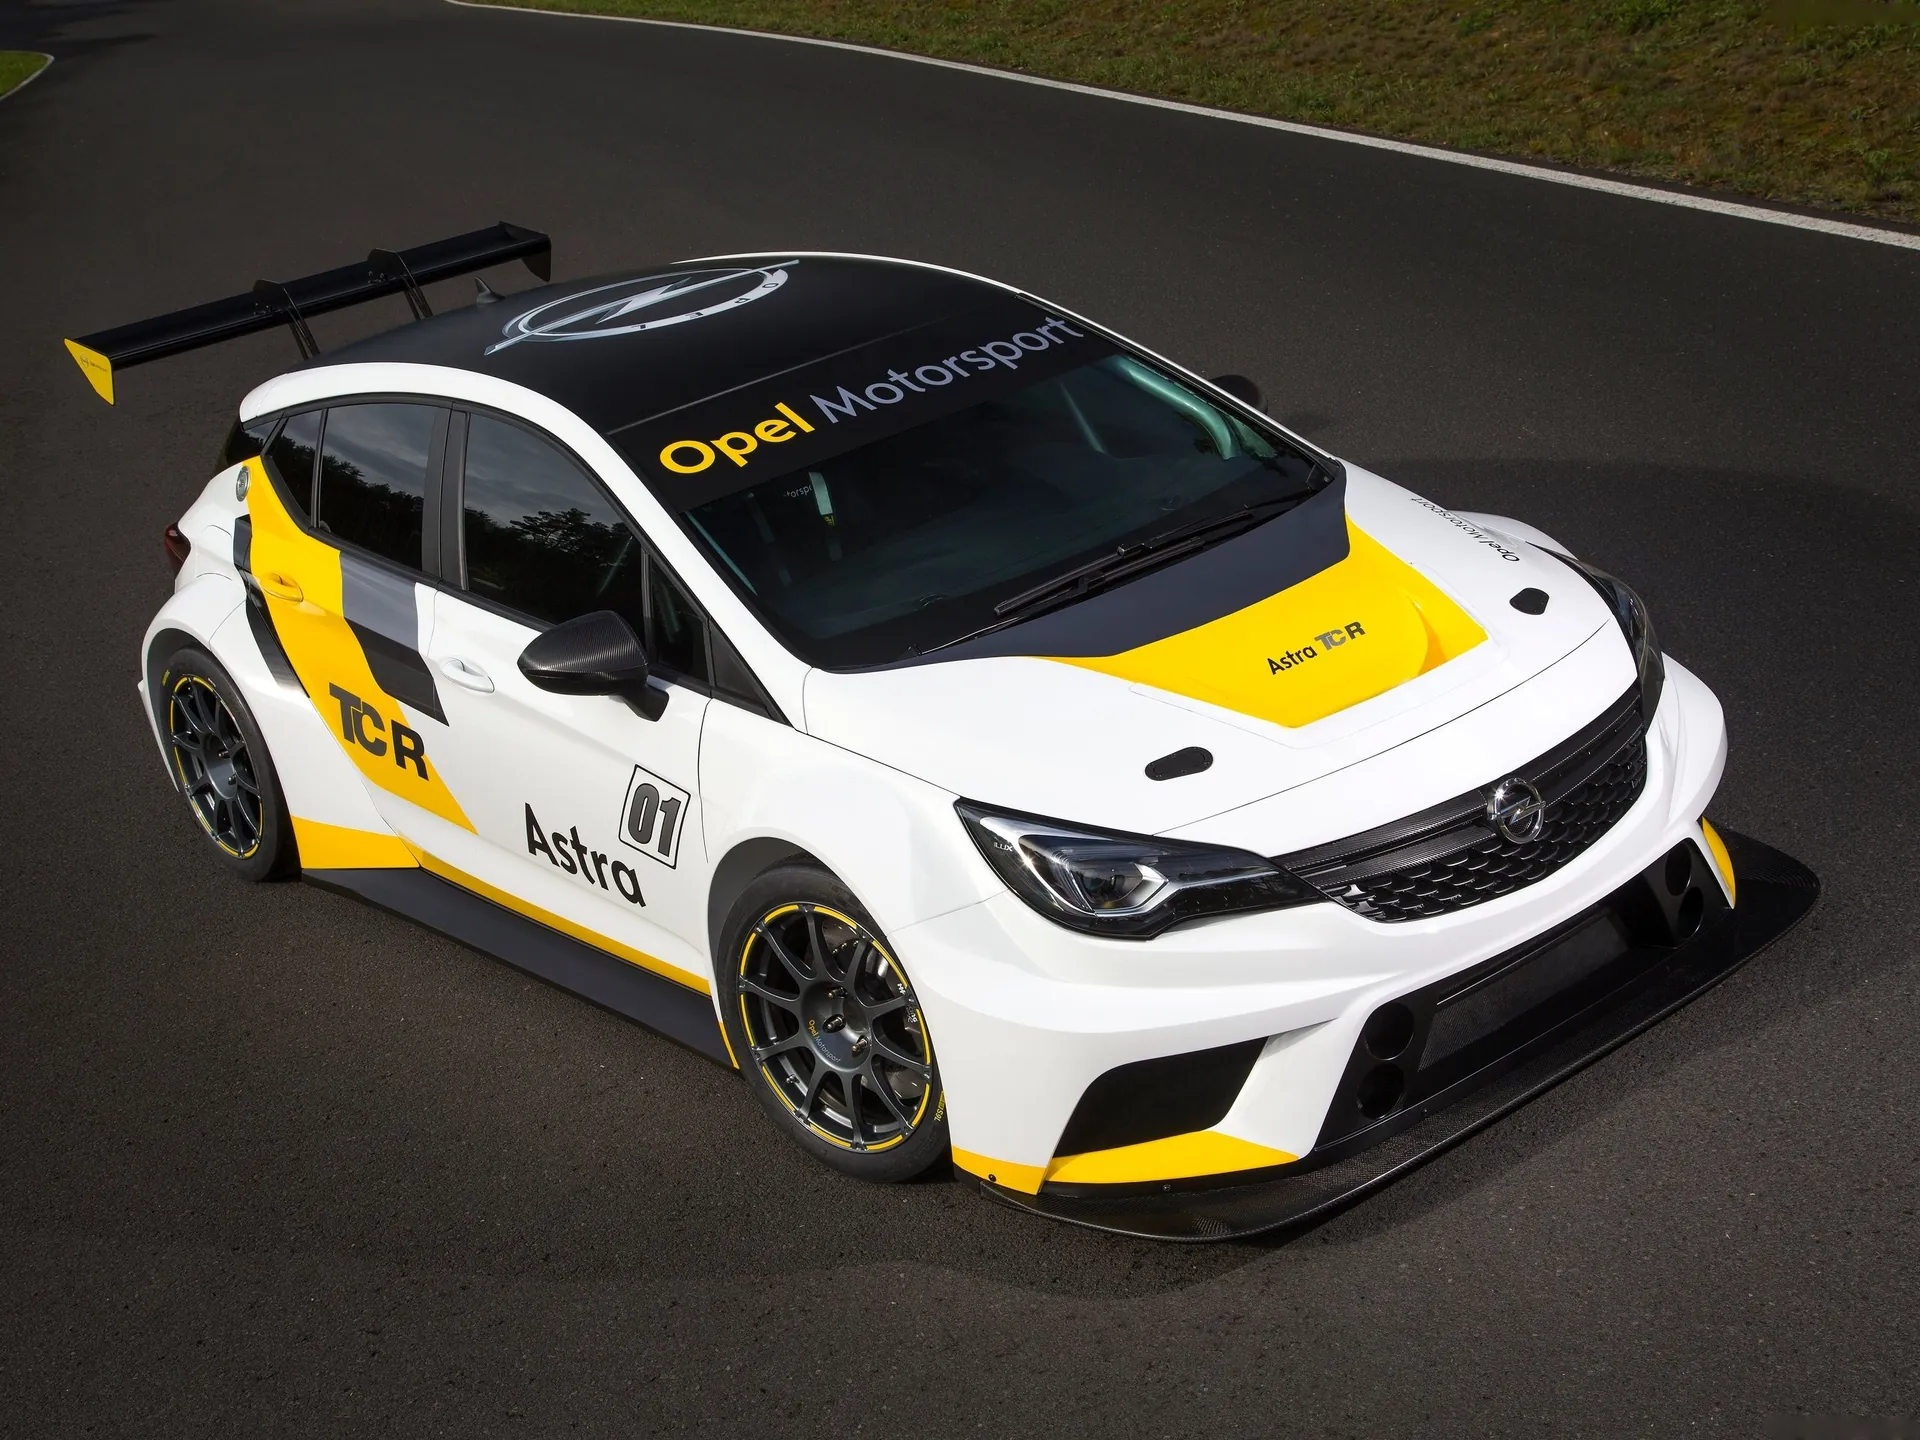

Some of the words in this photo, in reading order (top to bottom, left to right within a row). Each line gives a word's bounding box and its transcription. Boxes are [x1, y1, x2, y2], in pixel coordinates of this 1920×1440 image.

[659, 402, 815, 474] Opel
[809, 316, 1084, 424] Motorsport
[1410, 497, 1488, 539] Motorsport
[1479, 540, 1520, 562] Opel
[1267, 644, 1318, 675] Astra
[627, 782, 682, 857] 01
[525, 802, 646, 908] Astra
[808, 1019, 819, 1037] Opel
[815, 1035, 841, 1063] Motorsport
